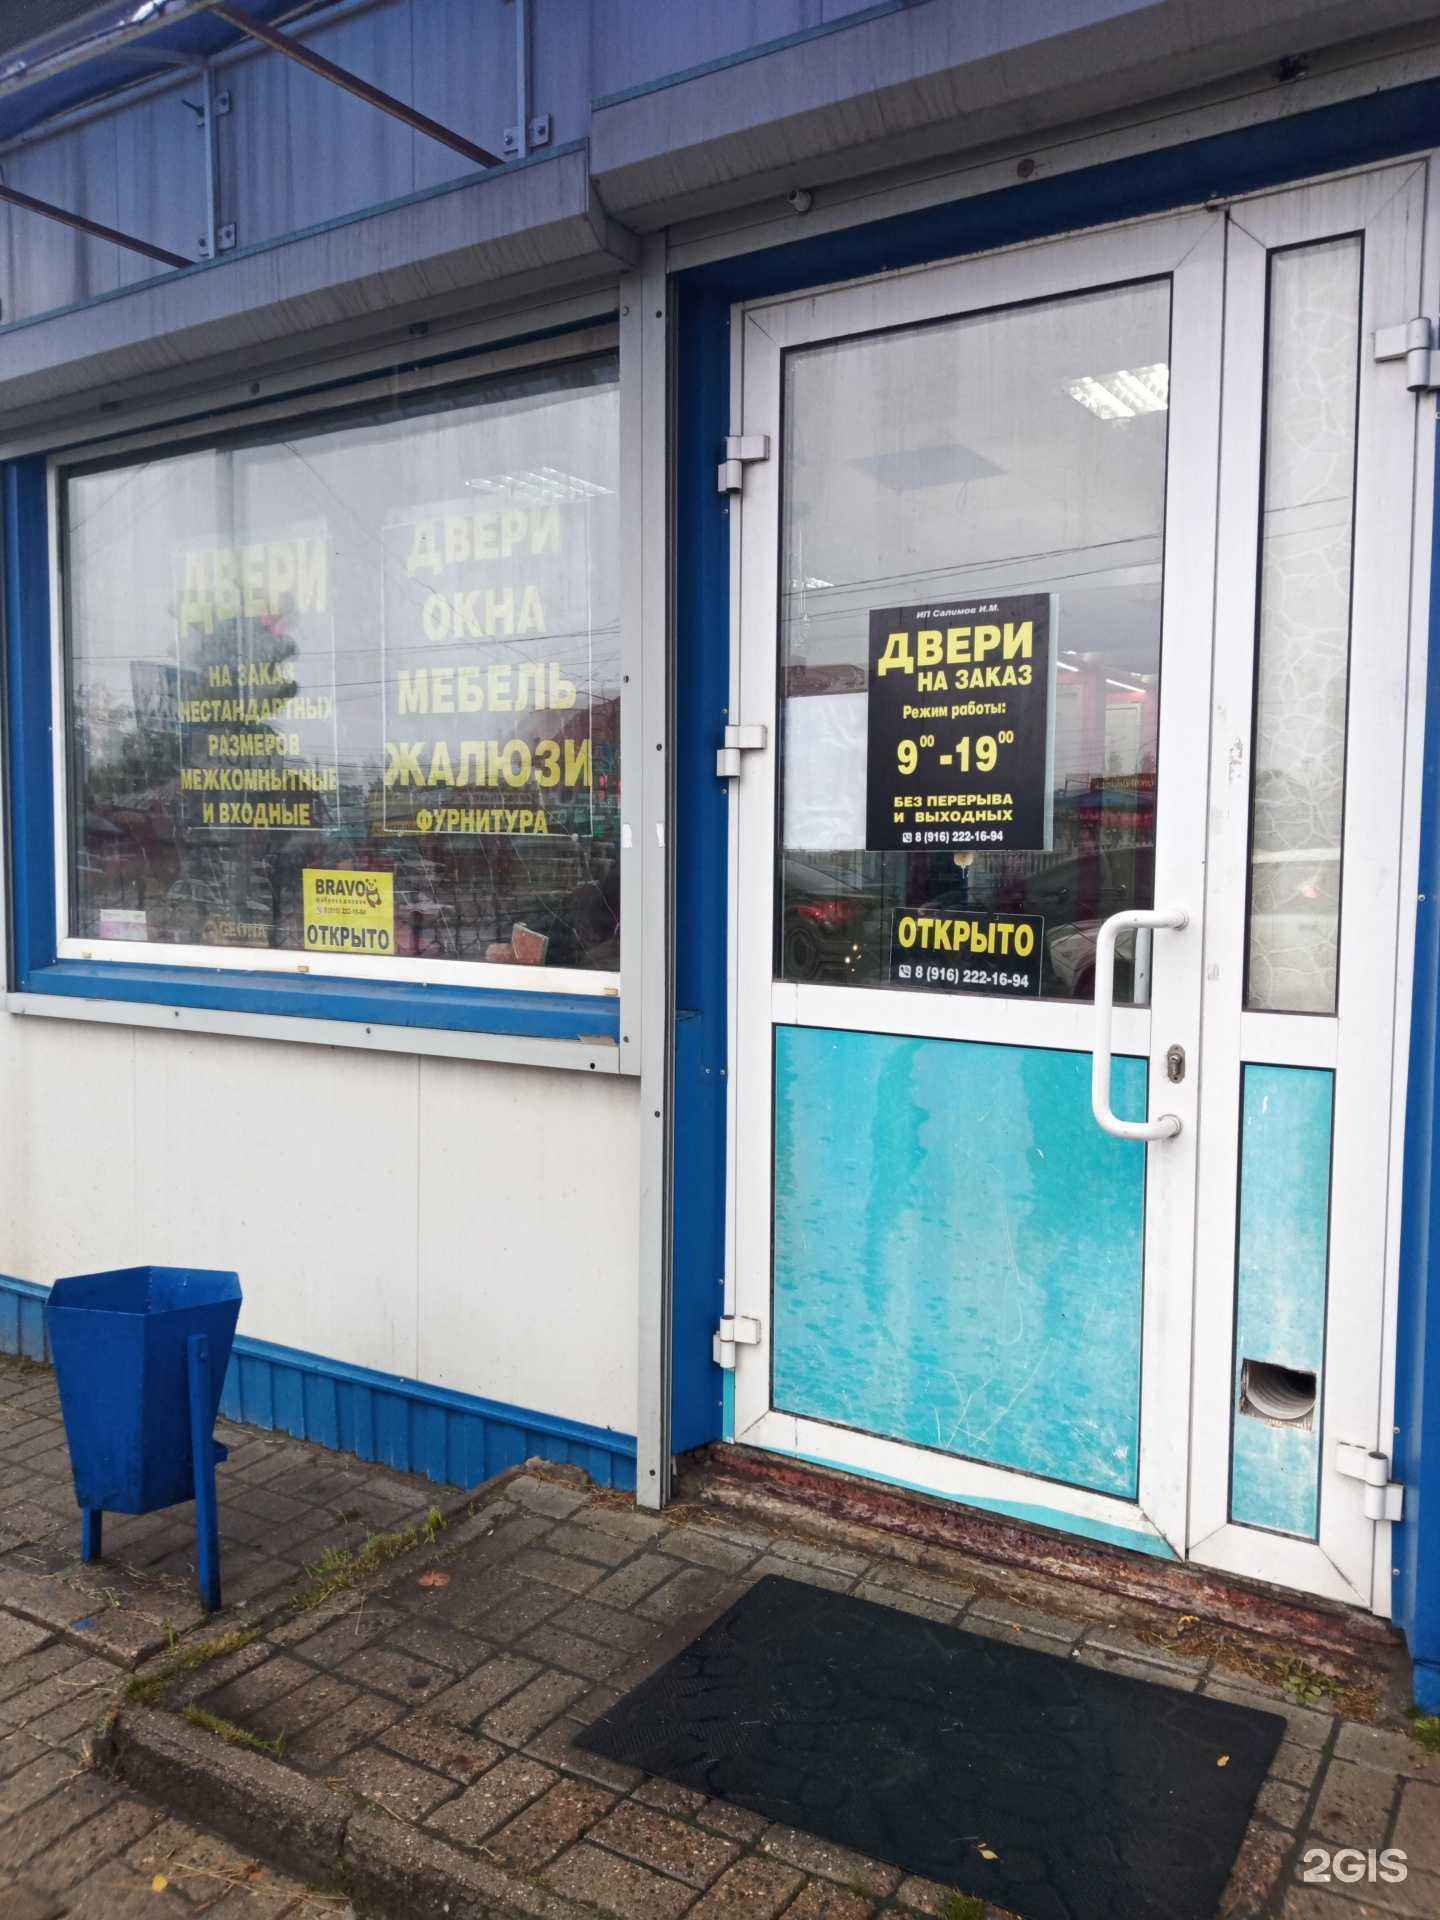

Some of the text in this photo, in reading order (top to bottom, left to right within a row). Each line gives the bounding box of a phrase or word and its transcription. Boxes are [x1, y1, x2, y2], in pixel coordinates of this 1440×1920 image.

[406, 510, 562, 578] ДВЕРИ
[180, 538, 328, 638] ДВЕРИ
[421, 585, 547, 642] ОКНА
[916, 610, 931, 619] ИП
[877, 621, 1034, 677] ДВЕРИ
[208, 664, 233, 688] НА
[397, 661, 578, 715] МЕБЕЛЬ
[917, 664, 1033, 693] НА ЗАКАЗ
[902, 700, 1007, 720] Режим работы:
[208, 733, 301, 758] РАЗМЕРОВ
[383, 738, 592, 790] ЖАЛЮЗИ
[894, 793, 1014, 808] БЕЗ ПЕРЕРЫВА
[202, 802, 311, 829] И ВХОДНЫЕ
[415, 808, 549, 834] ФУРНИТУРА
[894, 809, 1014, 824] И ВЫХОДНЫХ
[915, 831, 1004, 844] 8 (916) 222-16-94
[315, 878, 366, 897] BRAVO
[306, 924, 390, 950] ОТКРЫТО
[898, 916, 1034, 957] ОТКРЫТО
[915, 965, 1029, 988] 8 (916) 222-16-94
